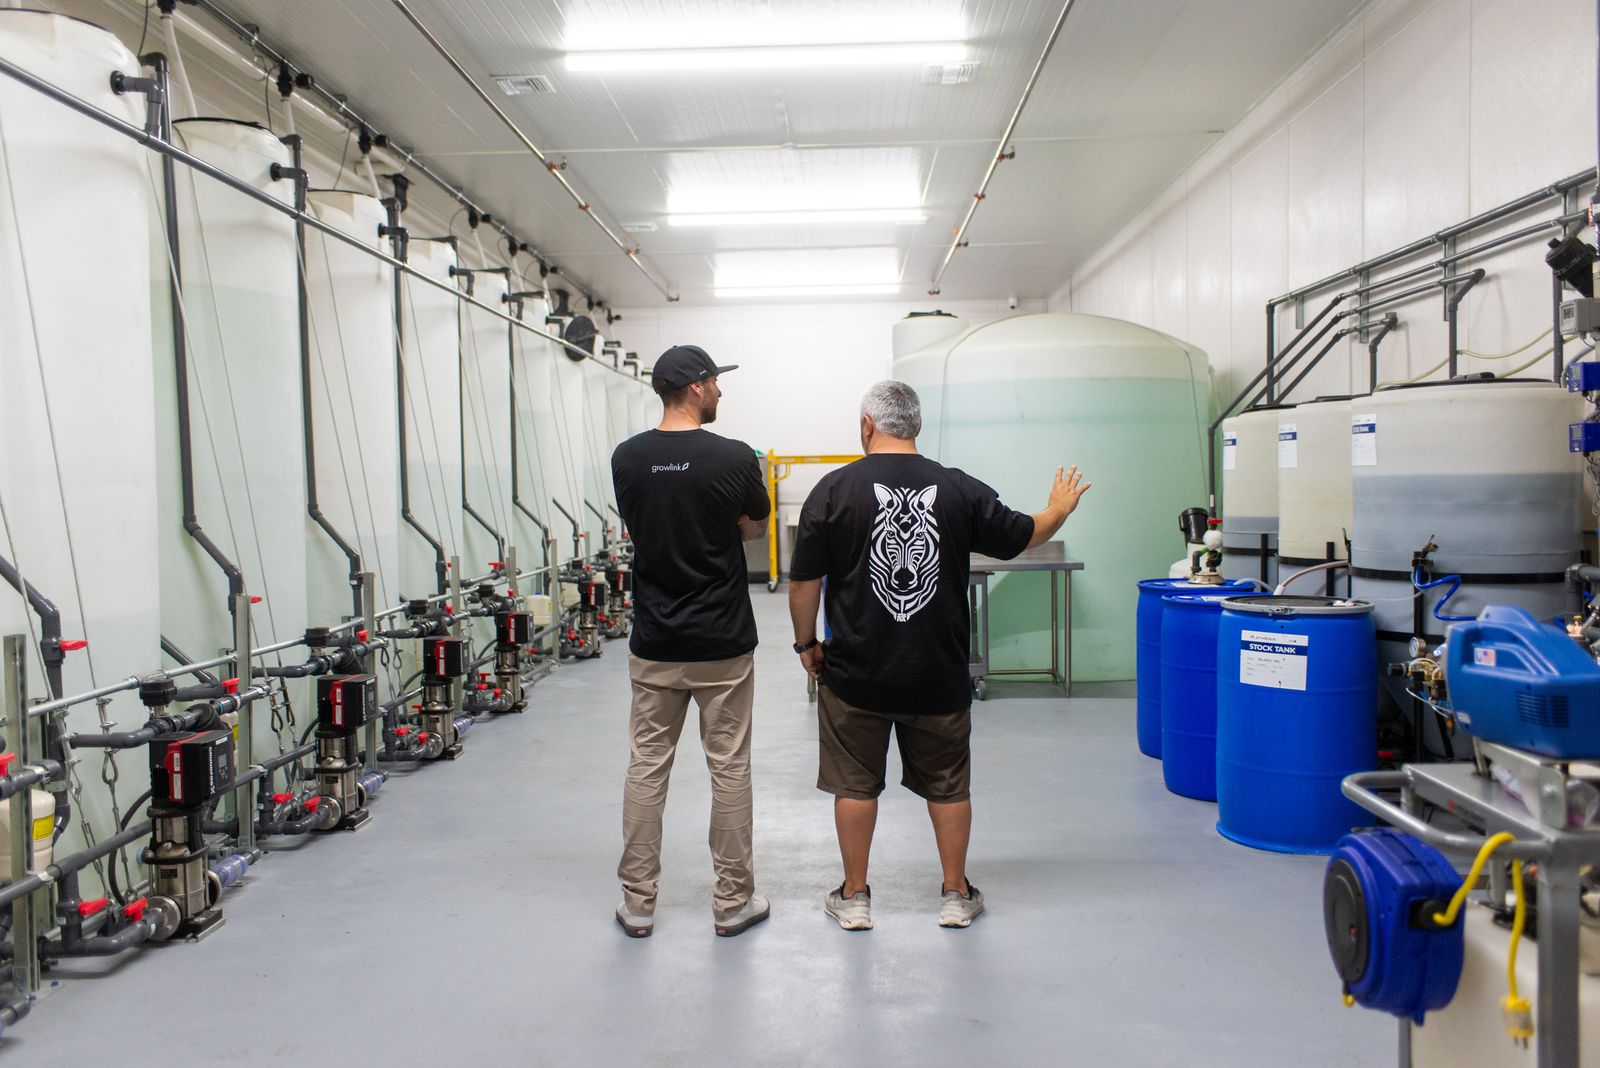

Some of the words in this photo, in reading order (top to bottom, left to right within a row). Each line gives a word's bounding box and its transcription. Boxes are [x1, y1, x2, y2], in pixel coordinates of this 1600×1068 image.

[651, 462, 682, 474] growlink
[1249, 643, 1273, 652] STOCK
[1274, 646, 1296, 654] TANK
